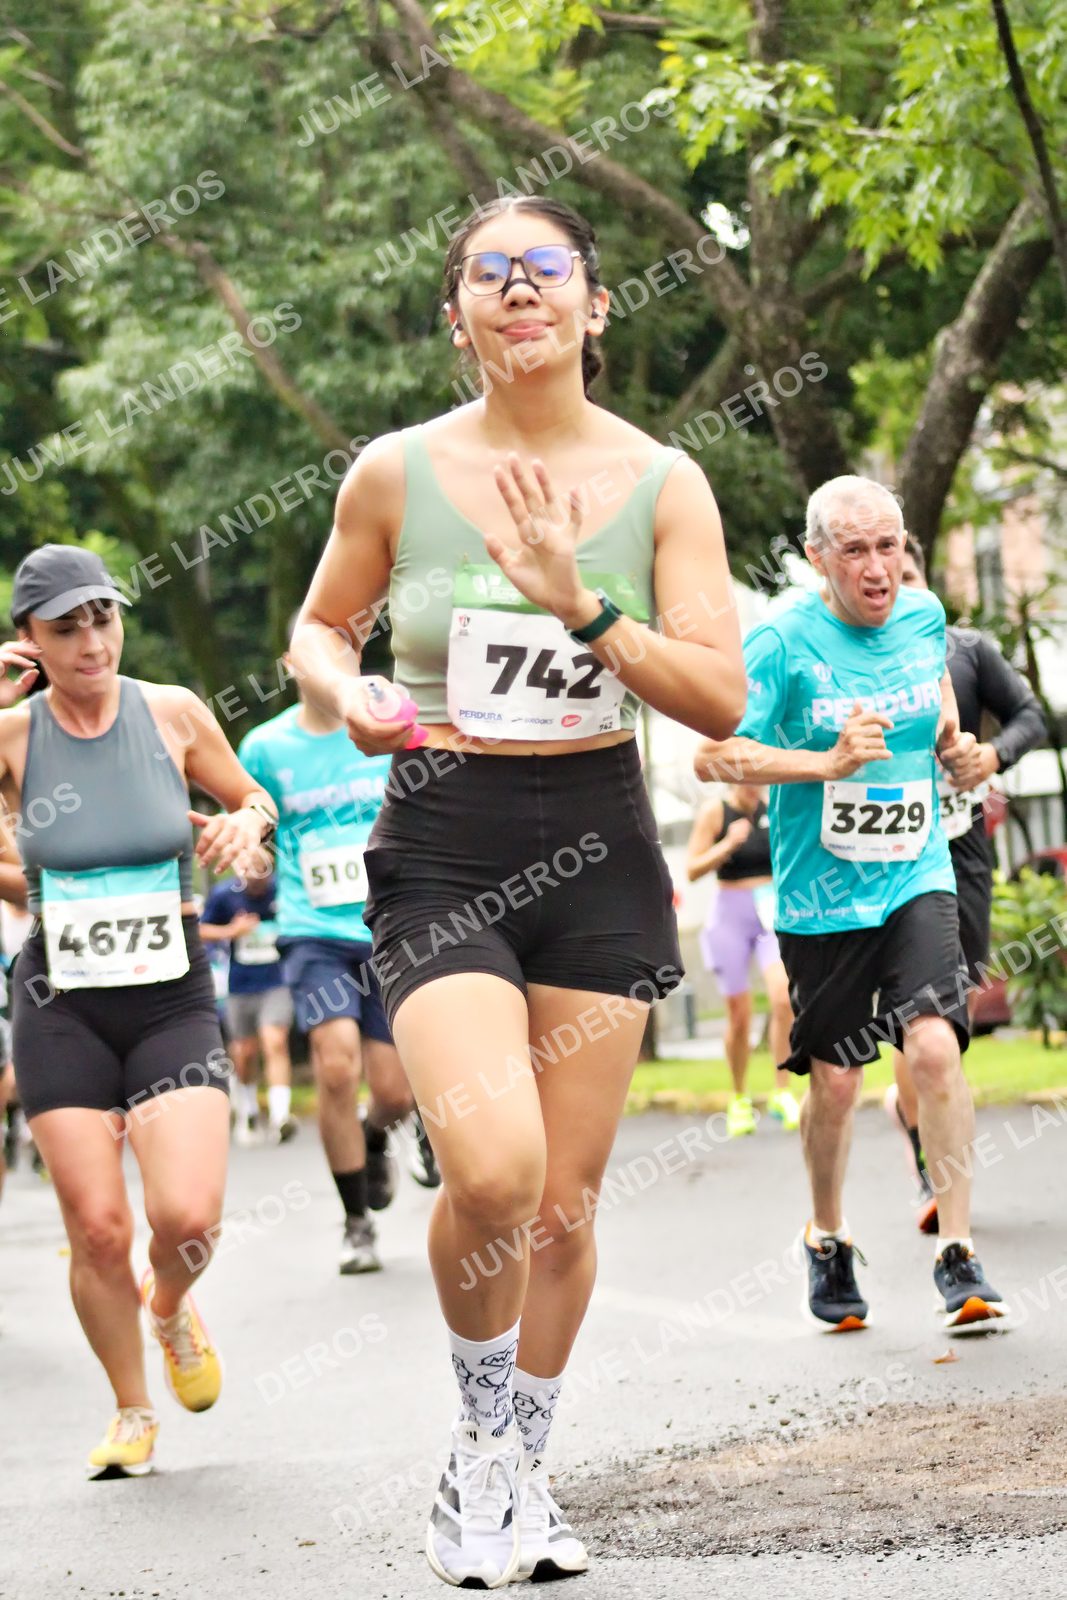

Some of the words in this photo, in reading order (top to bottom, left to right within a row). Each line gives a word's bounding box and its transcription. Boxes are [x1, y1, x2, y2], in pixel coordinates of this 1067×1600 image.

[486, 644, 605, 699] 742
[459, 709, 503, 721] PERDURA
[831, 802, 926, 834] 3229
[59, 915, 172, 957] 4673
